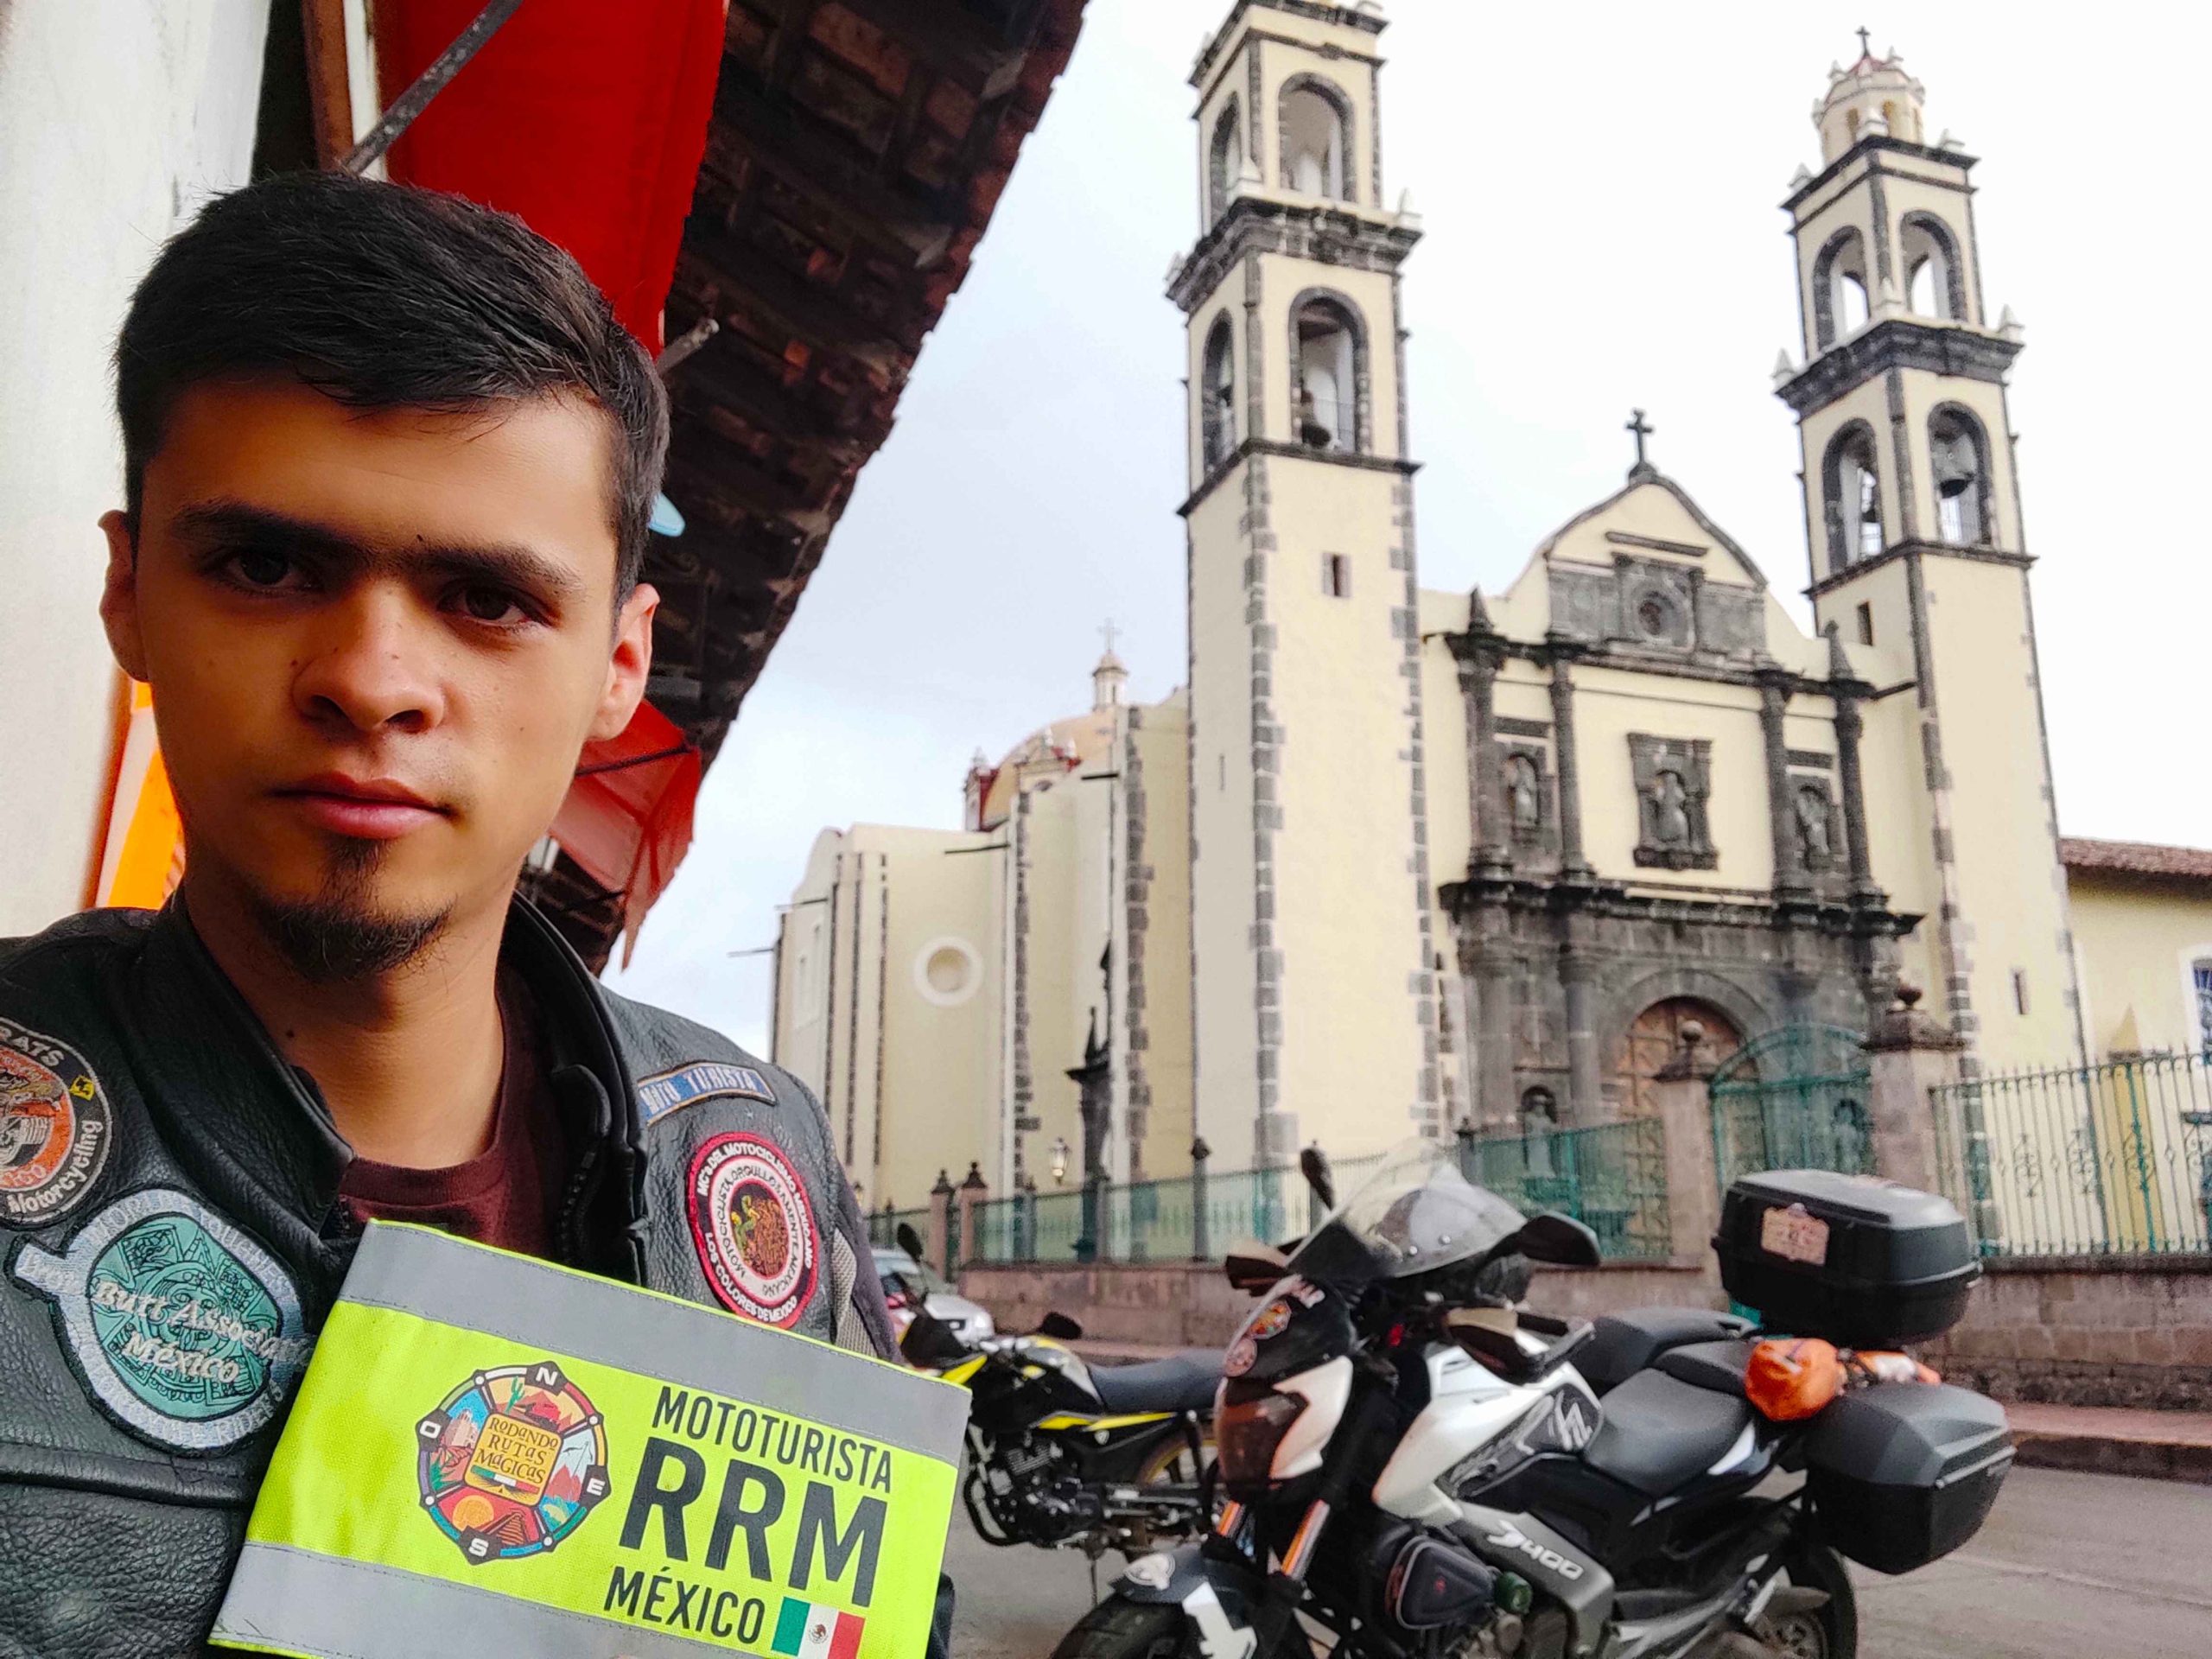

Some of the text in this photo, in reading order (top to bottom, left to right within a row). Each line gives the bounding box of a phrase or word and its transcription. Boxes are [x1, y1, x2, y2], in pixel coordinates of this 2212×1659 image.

[639, 1066, 758, 1115] MOTO TURISTA
[7, 1121, 103, 1213] Motorcycling
[723, 1142, 797, 1193] MOTOCICLISMO
[793, 1192, 813, 1268] MEXICANO
[717, 1177, 746, 1278] MOTOCICLISTA
[731, 1165, 799, 1249] ORGULLOSAMENTE
[89, 1281, 170, 1321] Butt
[705, 1232, 720, 1263] LOS
[715, 1265, 758, 1316] COLORES
[122, 1331, 239, 1382] México
[536, 1367, 557, 1386] N
[419, 1421, 441, 1439] O
[652, 1386, 891, 1493] MOTOTURISTA
[586, 1478, 606, 1497] E
[619, 1436, 887, 1608] RRM
[468, 1538, 490, 1557] S
[604, 1567, 766, 1643] MÉXICO
